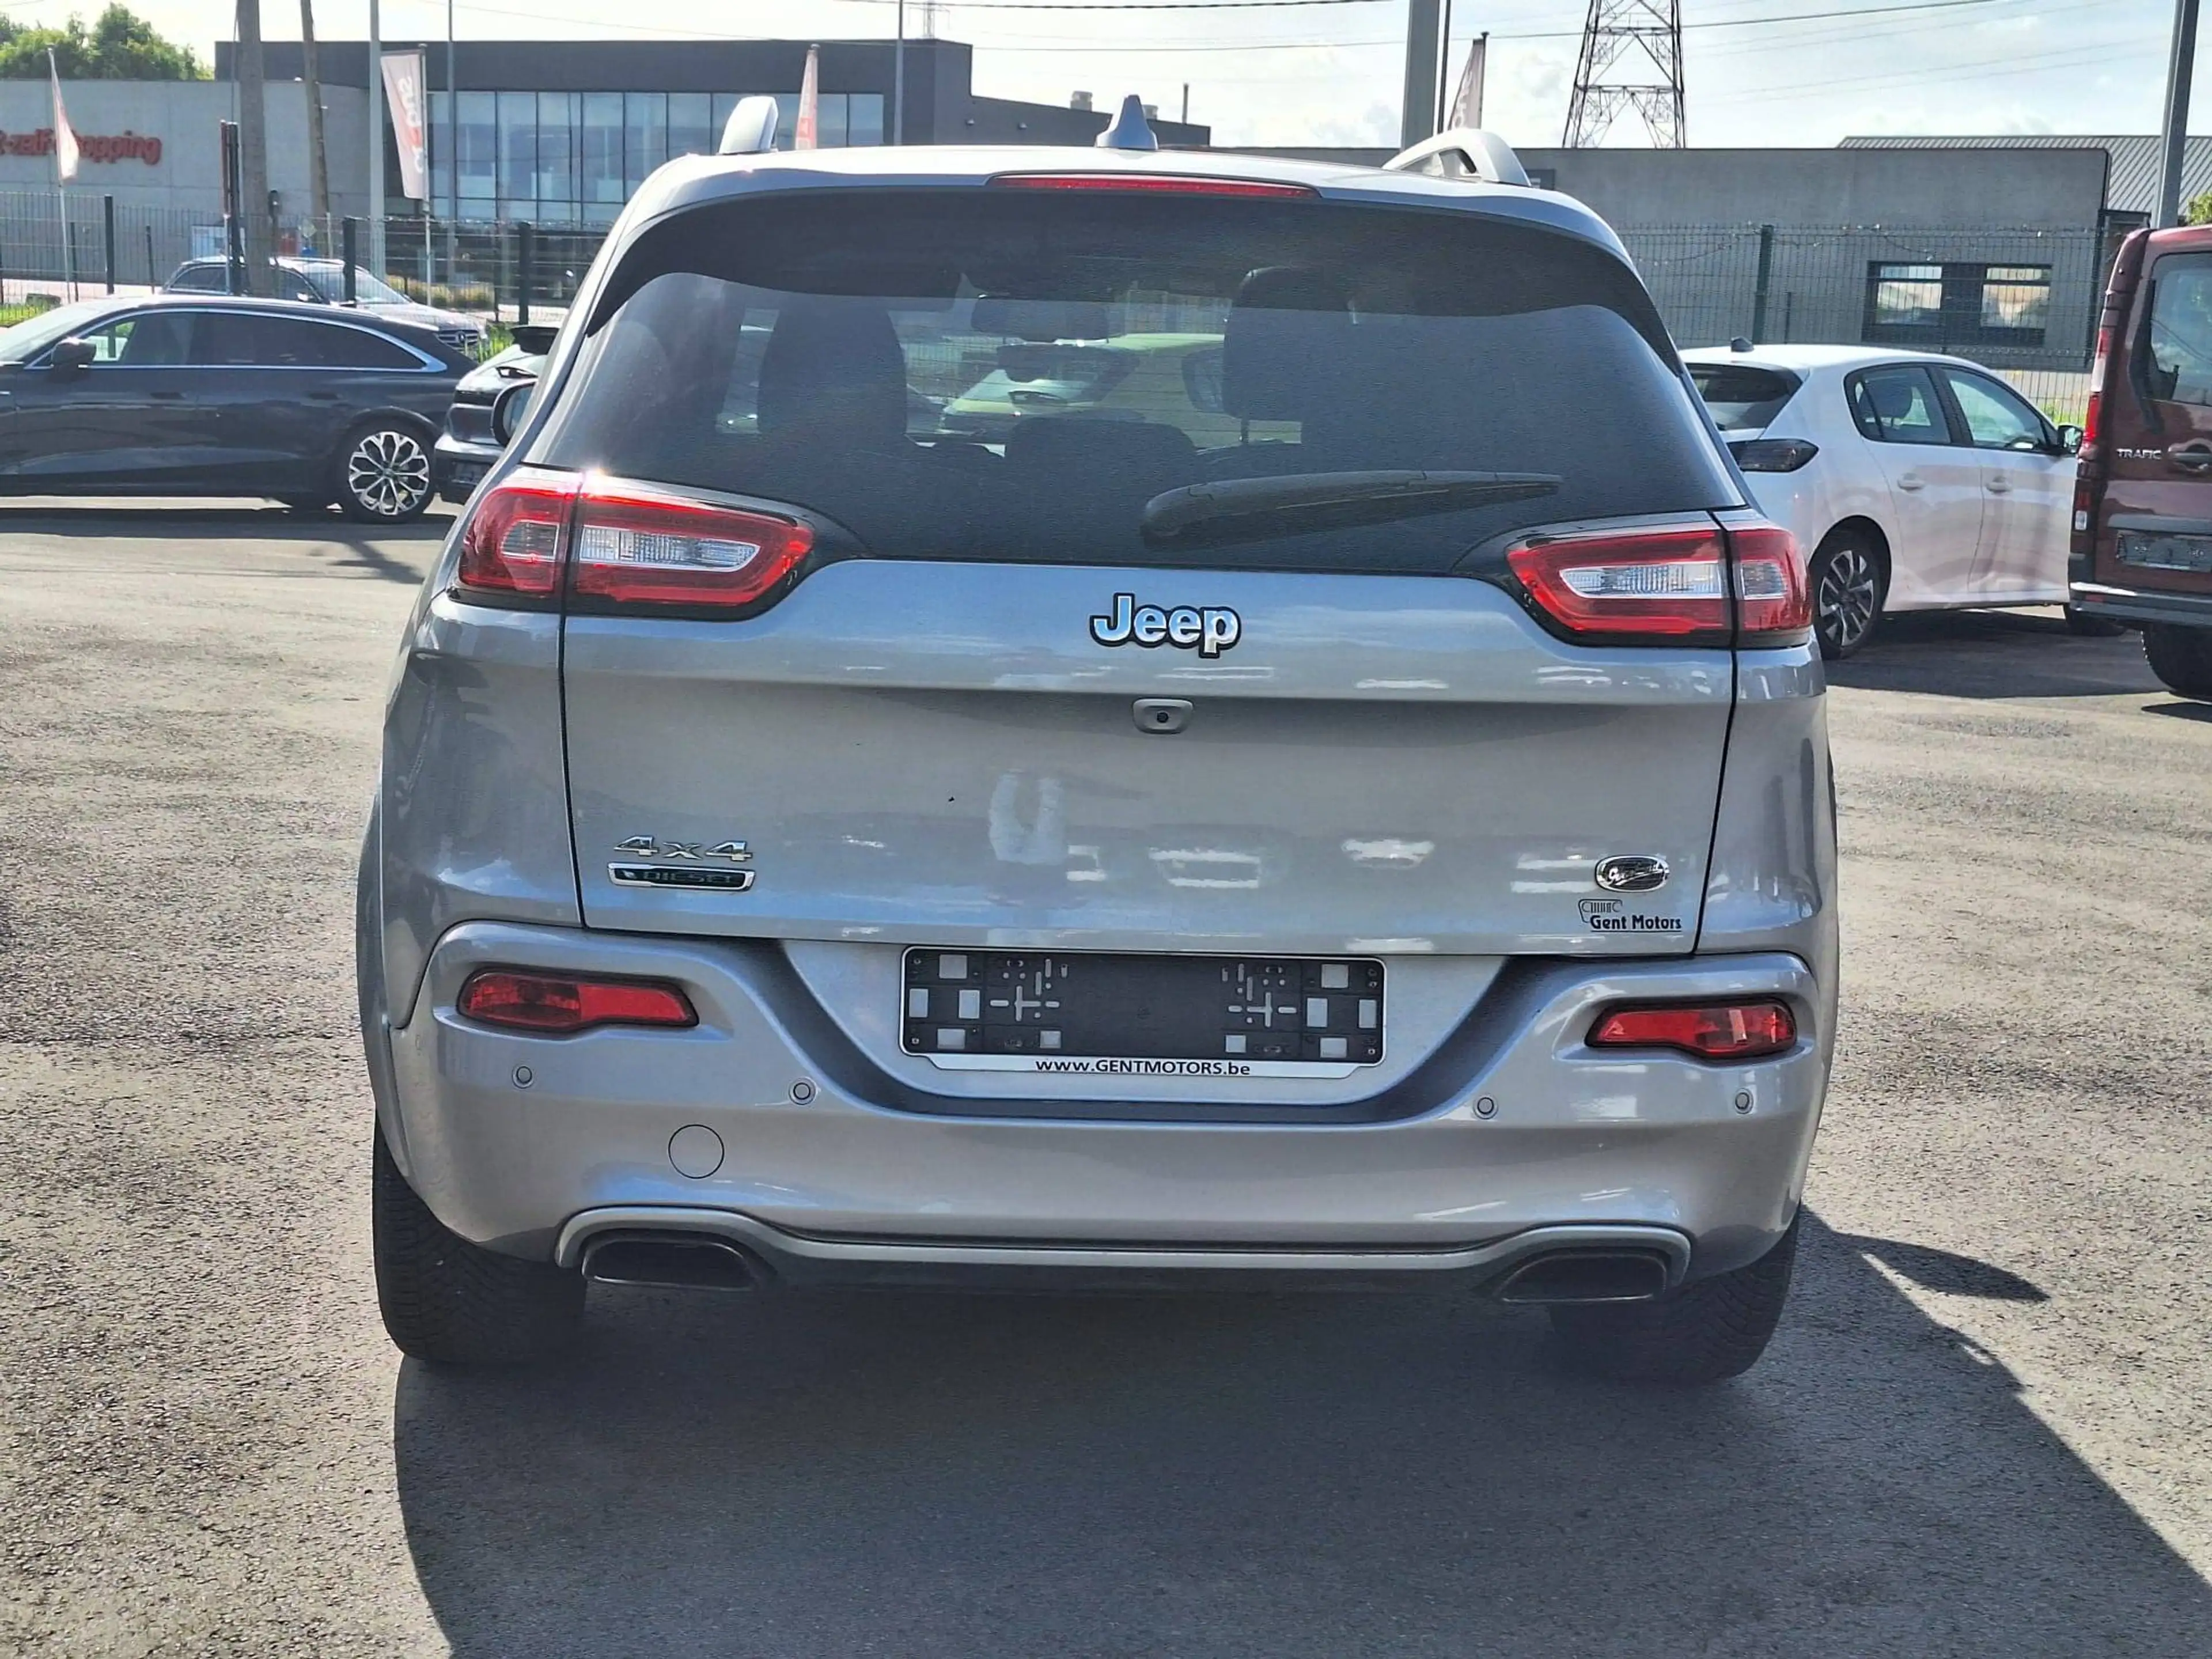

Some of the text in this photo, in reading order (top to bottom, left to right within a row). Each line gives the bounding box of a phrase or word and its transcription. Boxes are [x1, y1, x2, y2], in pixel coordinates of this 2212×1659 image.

[2116, 447, 2162, 460] TRAFIC
[1090, 592, 1241, 658] Jeep
[1590, 915, 1682, 930] Gent Motors
[1036, 1059, 1251, 1075] www.GENTMOTORS.be
